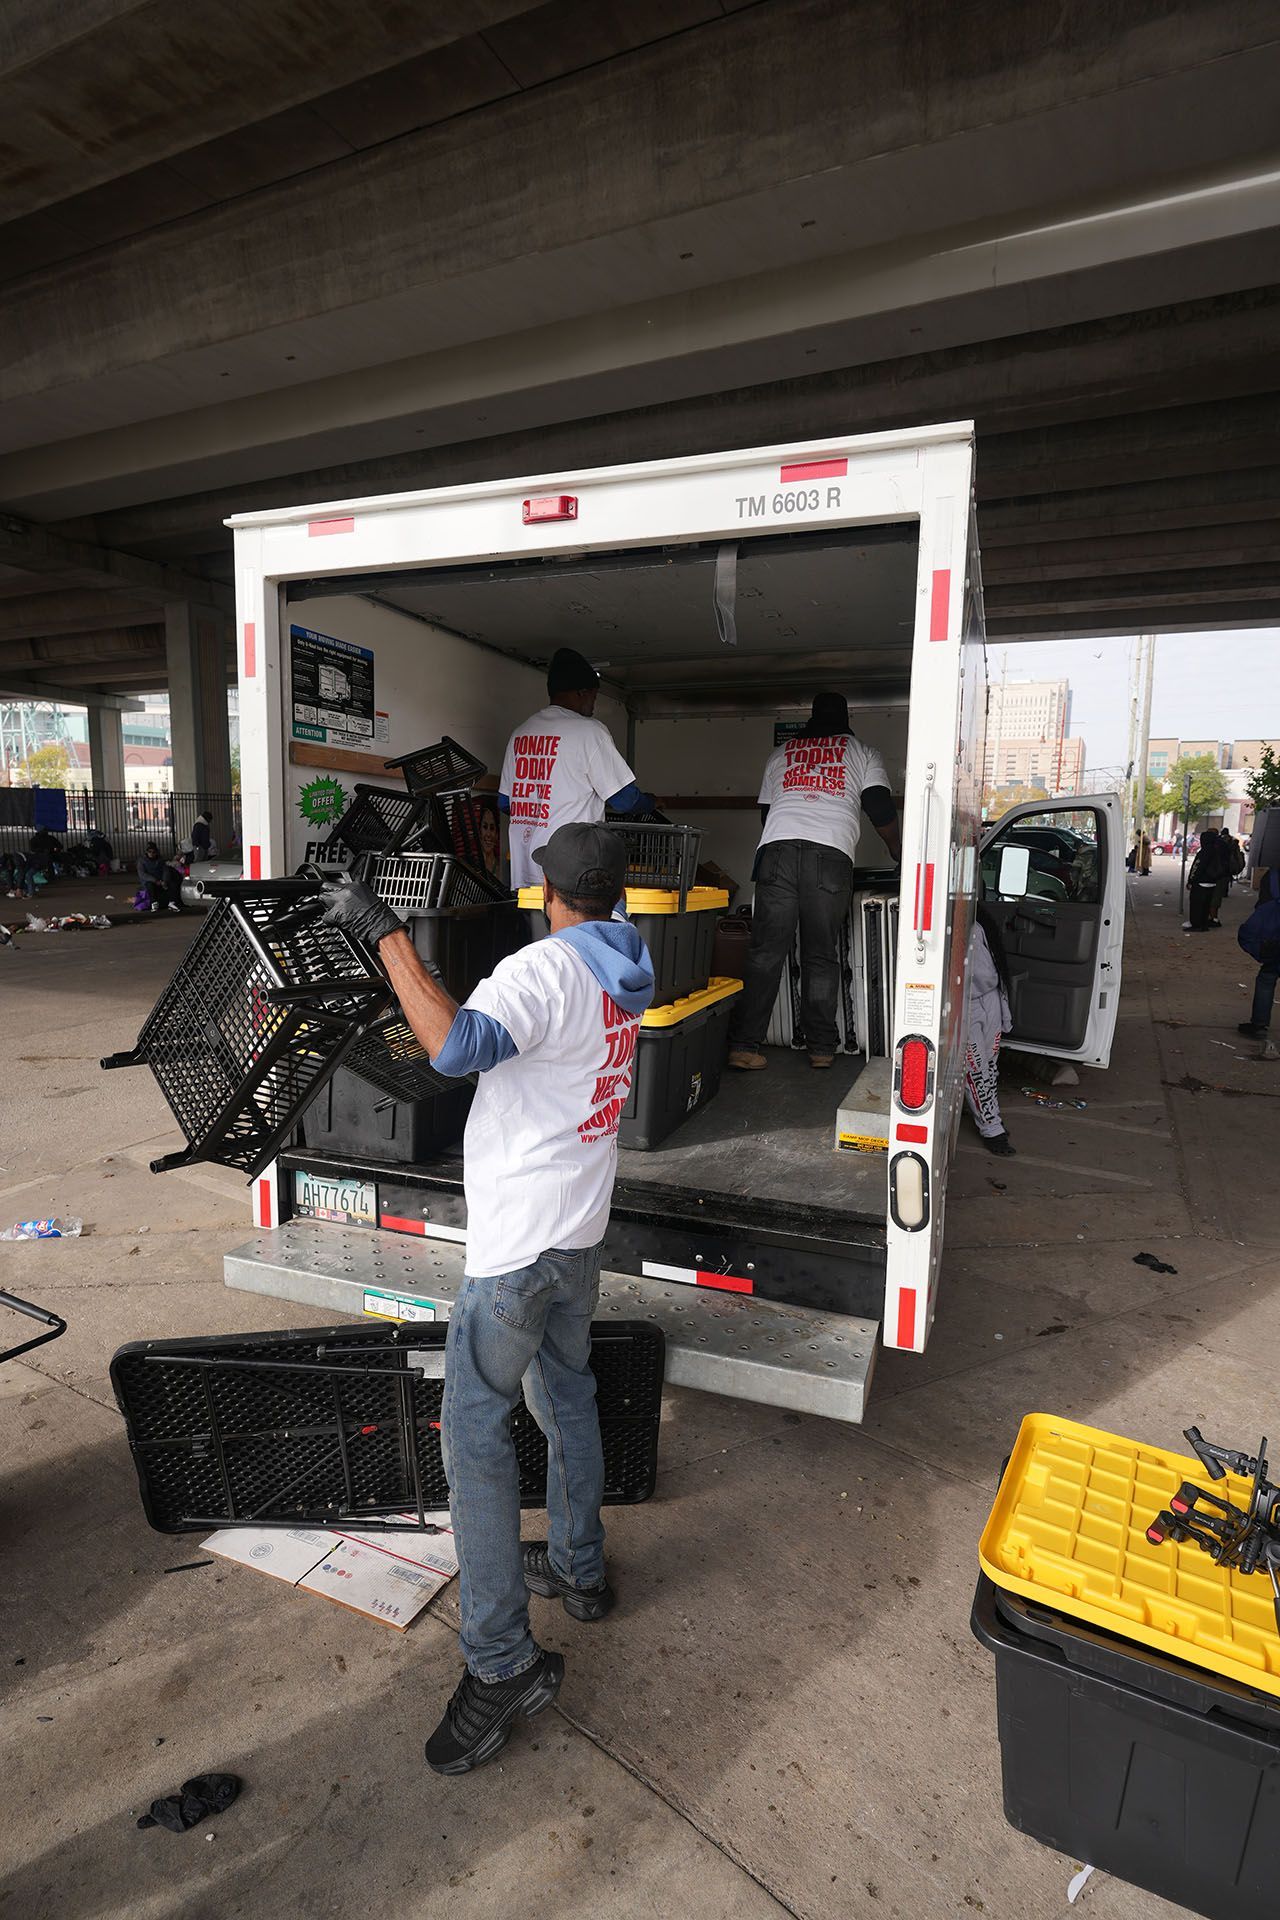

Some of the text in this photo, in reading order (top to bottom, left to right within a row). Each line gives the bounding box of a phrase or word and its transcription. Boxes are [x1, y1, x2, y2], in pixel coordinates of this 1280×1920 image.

[735, 486, 841, 518] TM 6603 R
[295, 727, 323, 738] ATTENTION
[784, 747, 847, 767] TODAY
[514, 757, 557, 781] ODAY
[820, 765, 847, 779] THE
[312, 796, 335, 808] OFFER
[303, 1182, 369, 1215] AH77674
